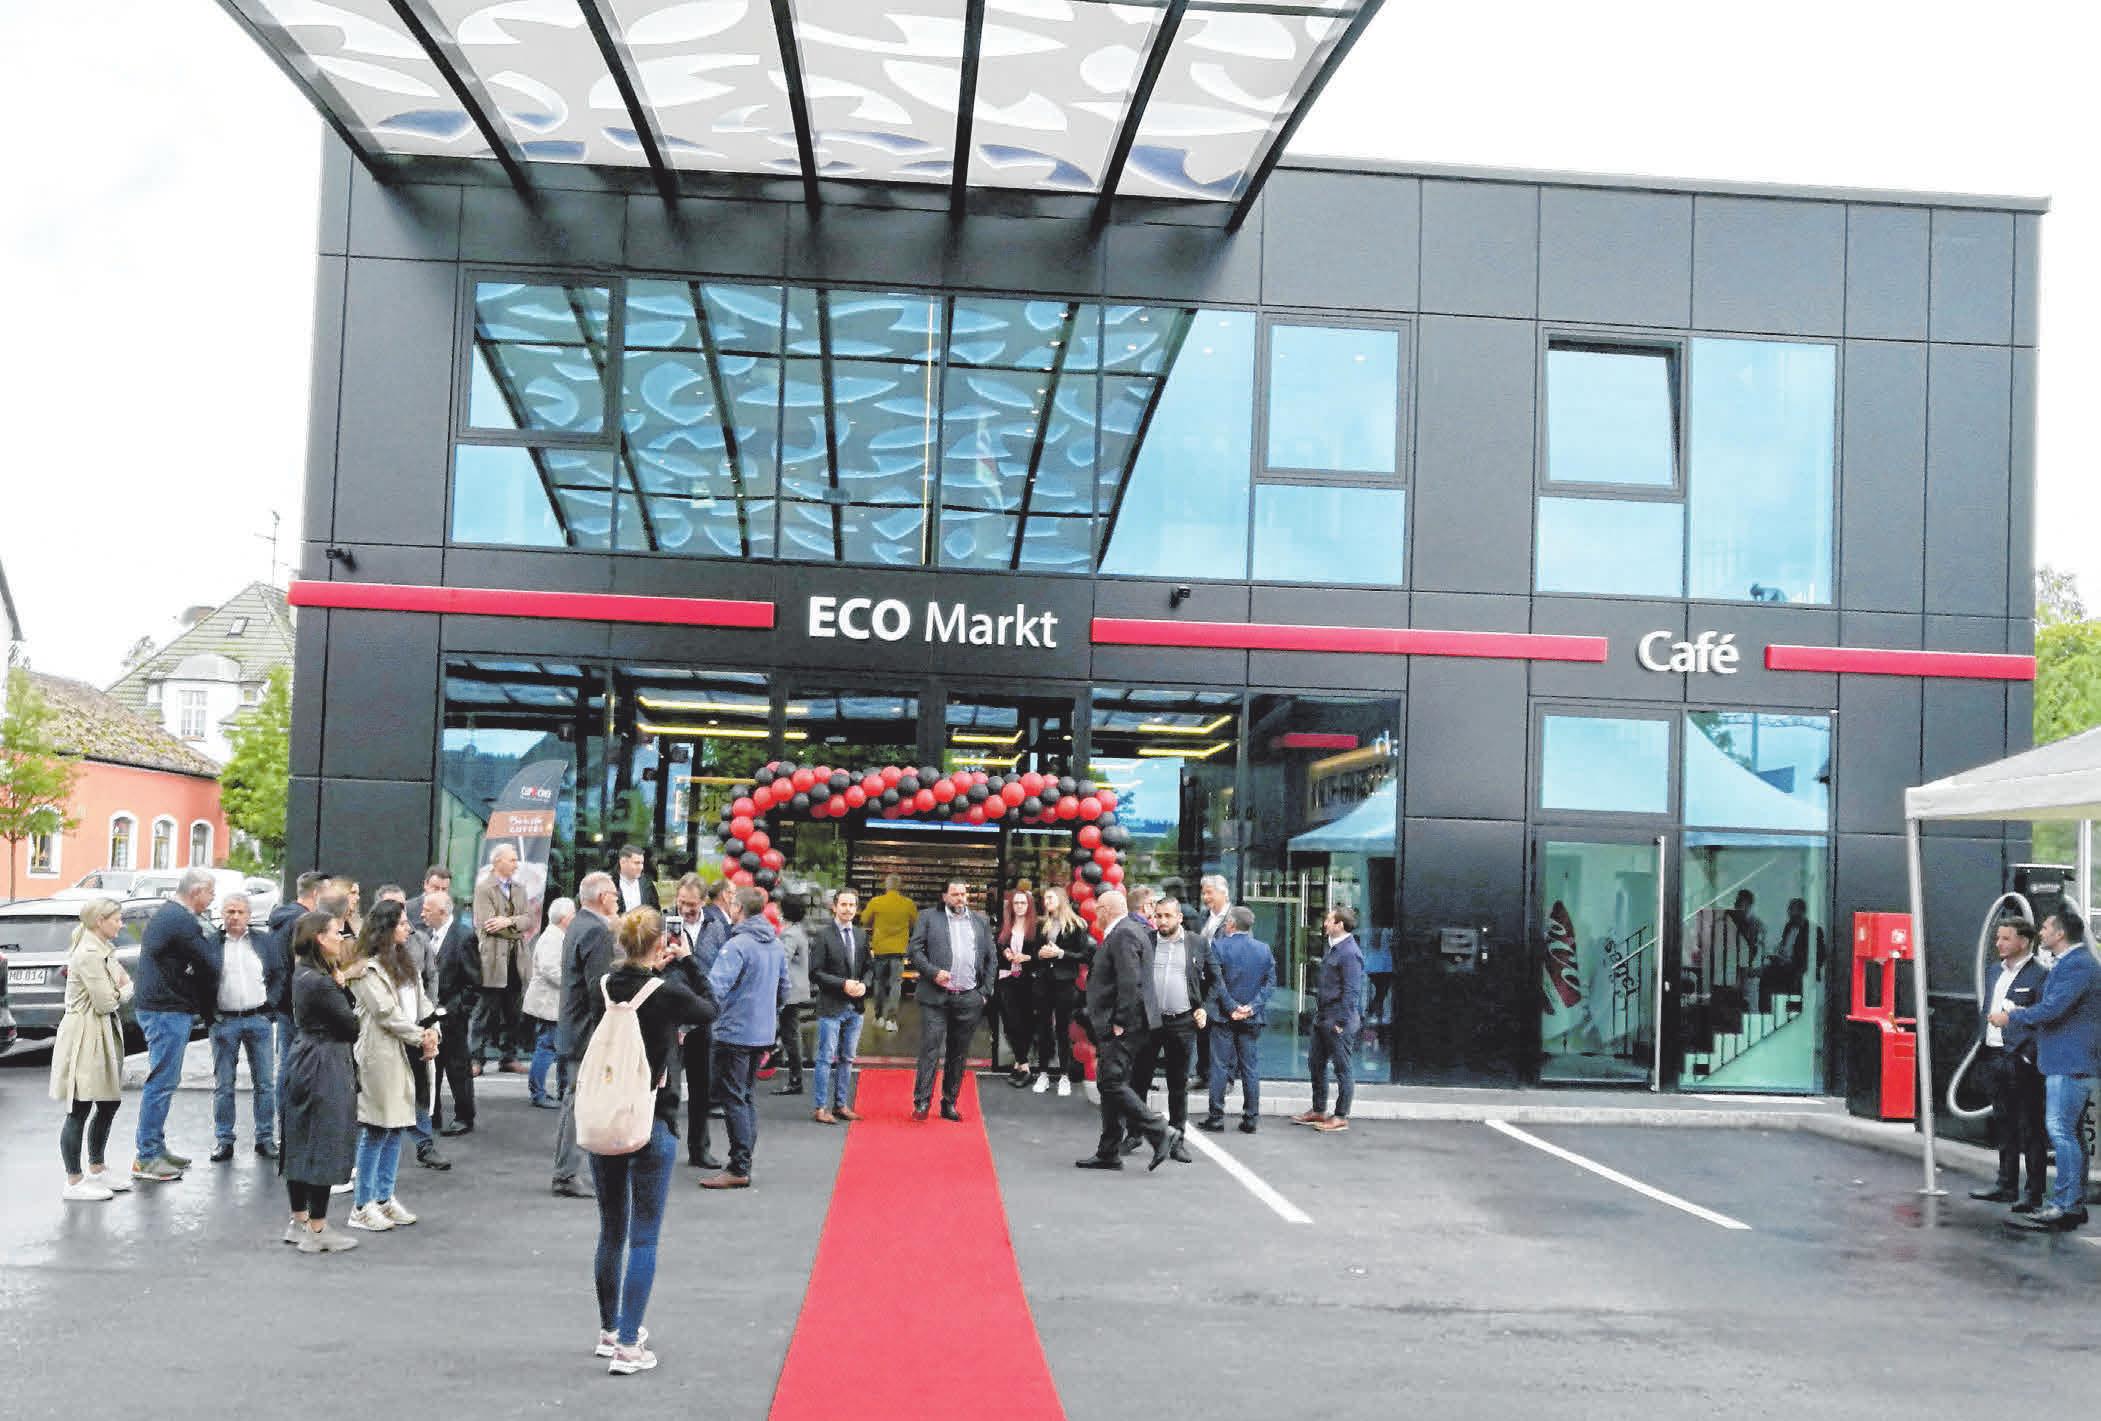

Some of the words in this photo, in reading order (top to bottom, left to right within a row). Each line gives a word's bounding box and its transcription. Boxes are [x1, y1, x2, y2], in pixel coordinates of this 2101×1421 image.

[808, 596, 911, 641] ECO
[924, 602, 1059, 648] Markt
[1638, 630, 1740, 674] Café
